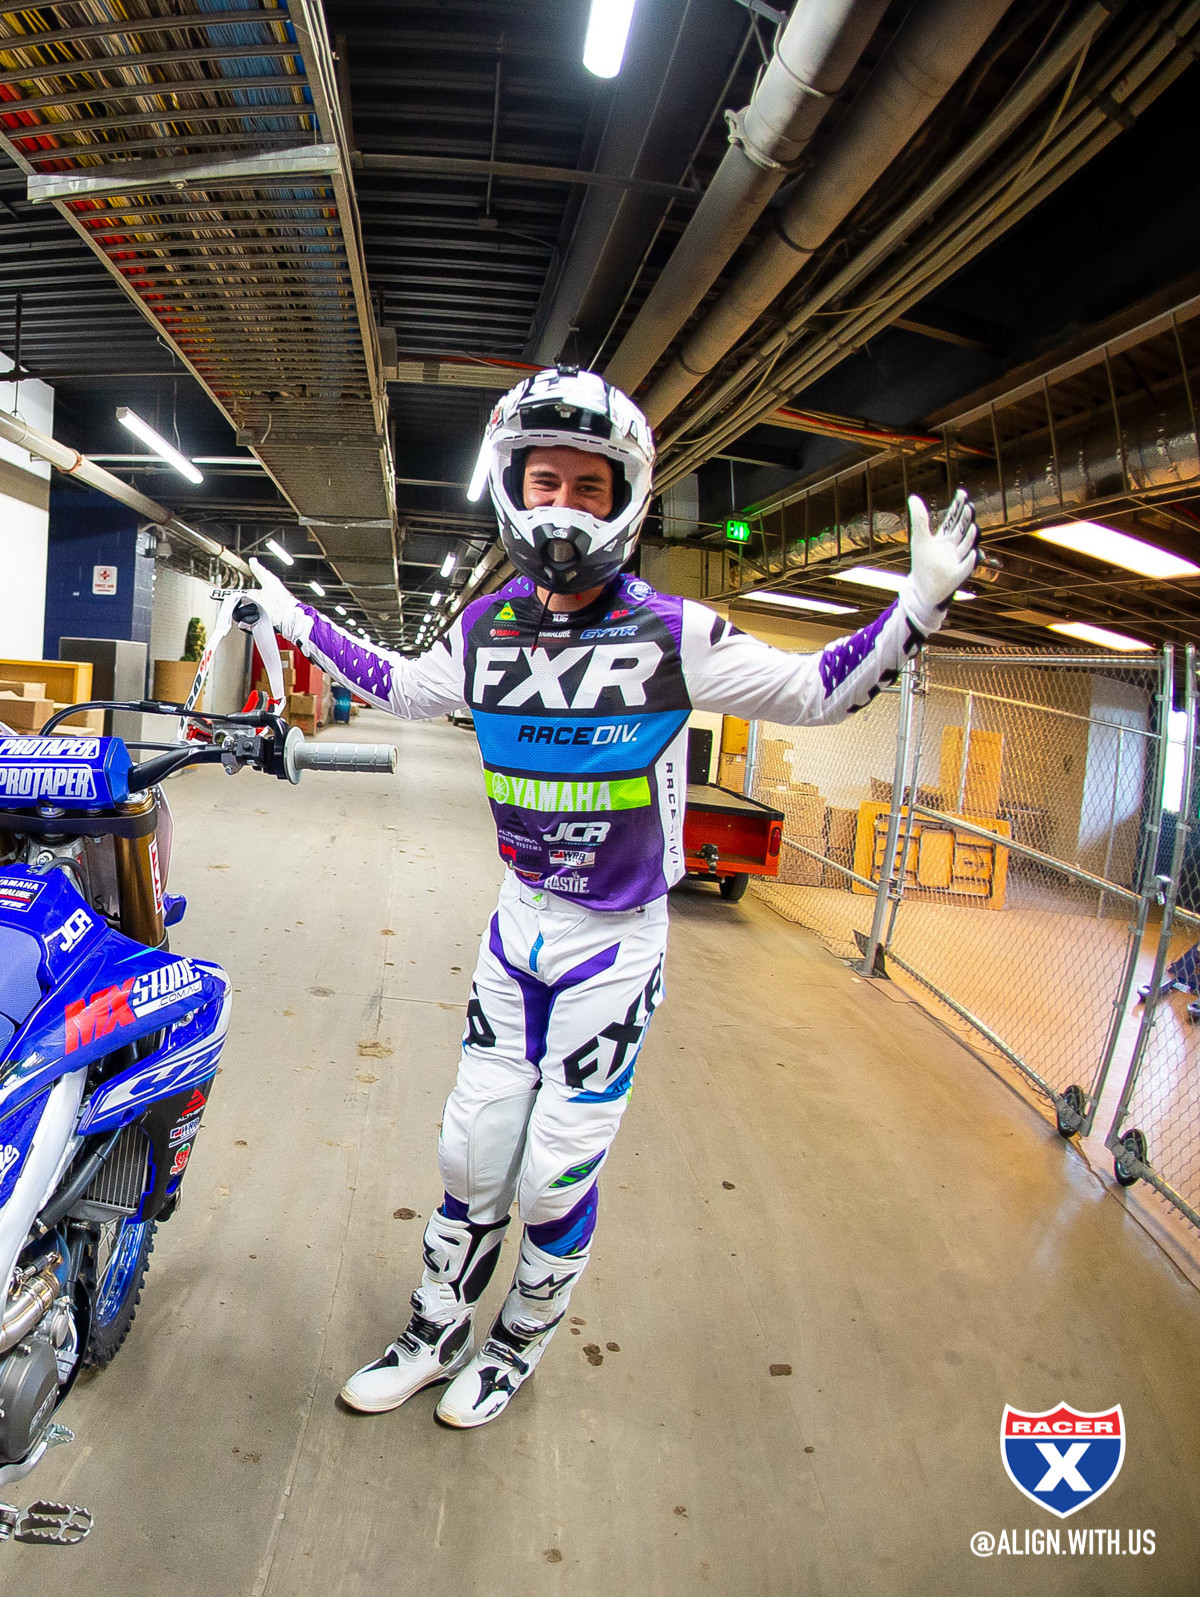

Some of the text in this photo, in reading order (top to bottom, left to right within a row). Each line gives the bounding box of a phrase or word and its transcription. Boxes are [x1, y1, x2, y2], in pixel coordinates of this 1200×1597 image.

[579, 625, 638, 639] GYTR
[473, 642, 663, 709] FXR
[510, 777, 612, 812] YAMAHA
[543, 822, 611, 843] JCR
[59, 908, 93, 952] JCR
[65, 977, 136, 1055] MX
[562, 952, 664, 1089] FXR
